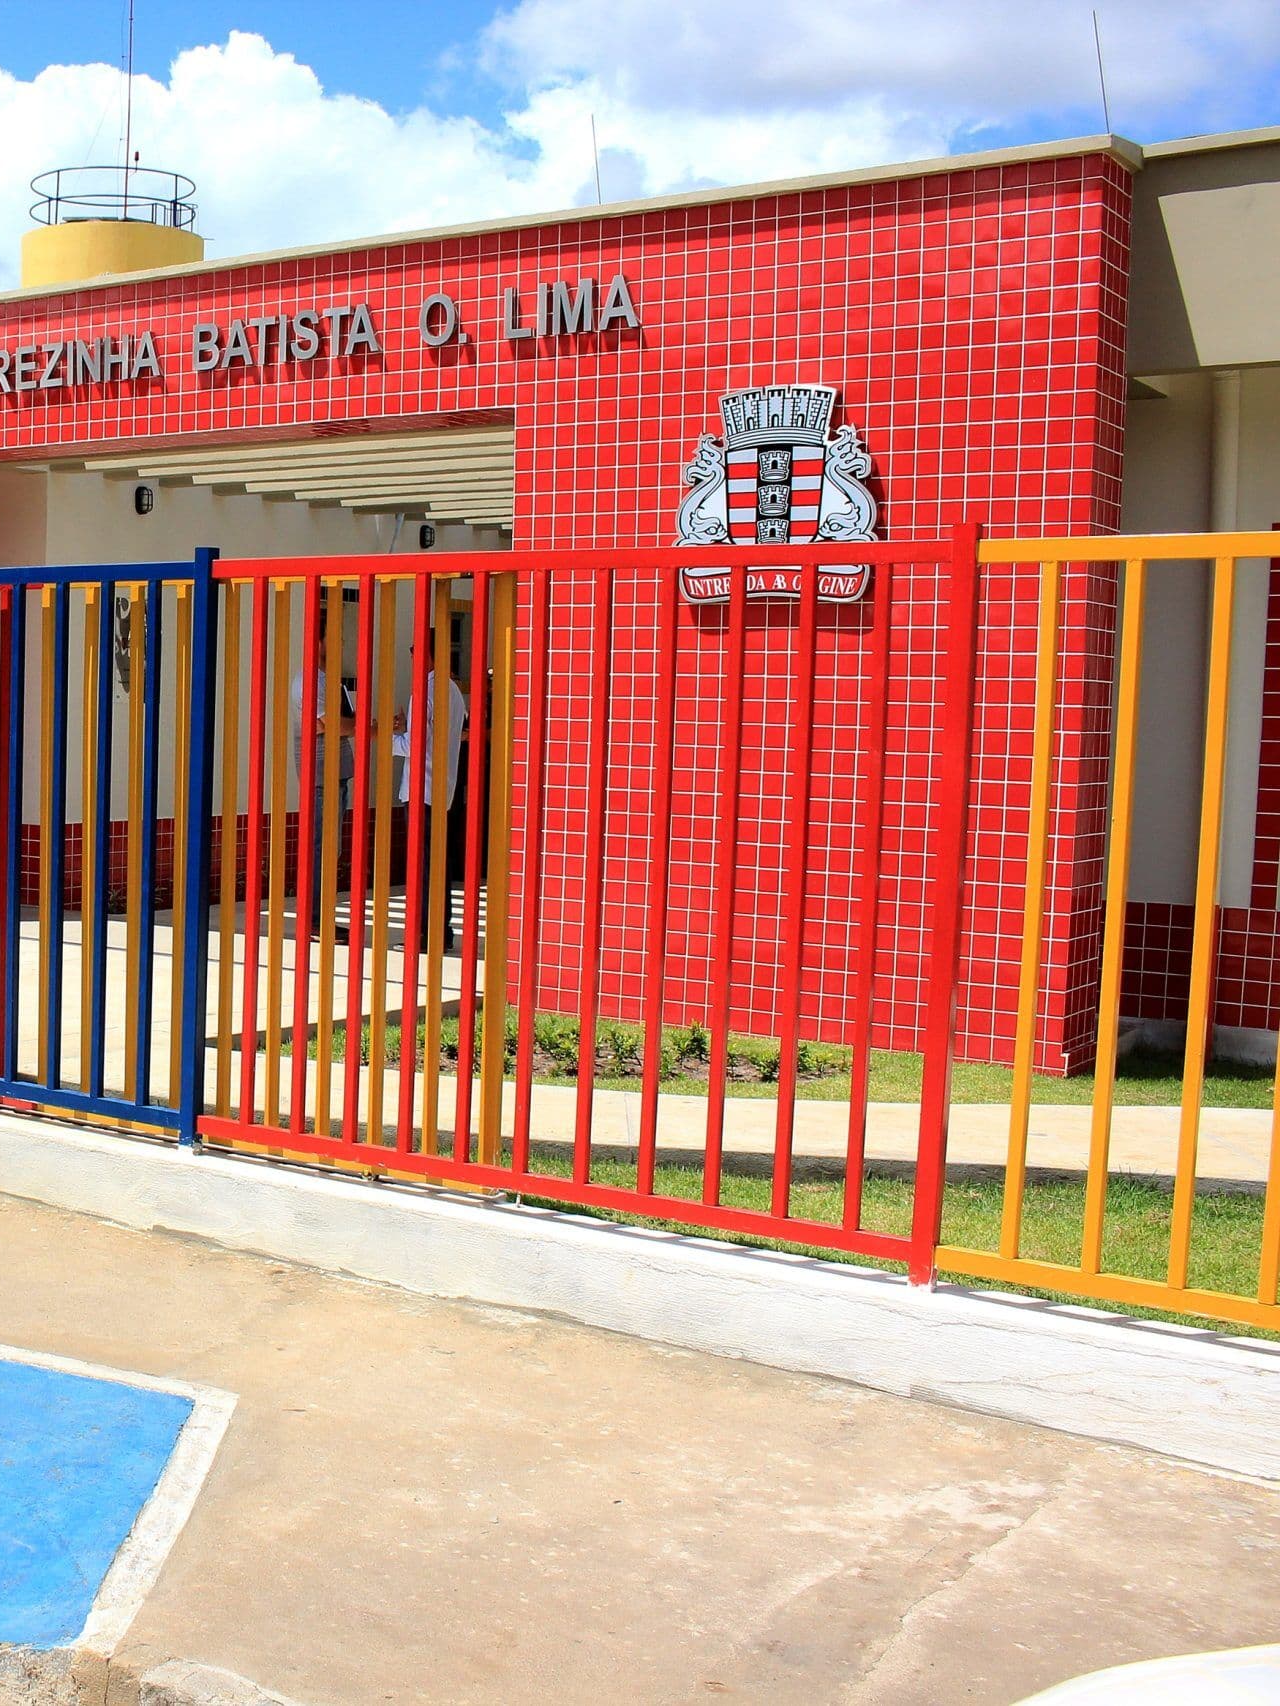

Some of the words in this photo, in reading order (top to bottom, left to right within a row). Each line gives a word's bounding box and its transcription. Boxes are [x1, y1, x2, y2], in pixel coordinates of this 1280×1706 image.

[192, 303, 380, 371] BATISTA
[419, 293, 467, 346] O.
[504, 274, 639, 339] LIMA
[688, 574, 765, 596] INTREDA
